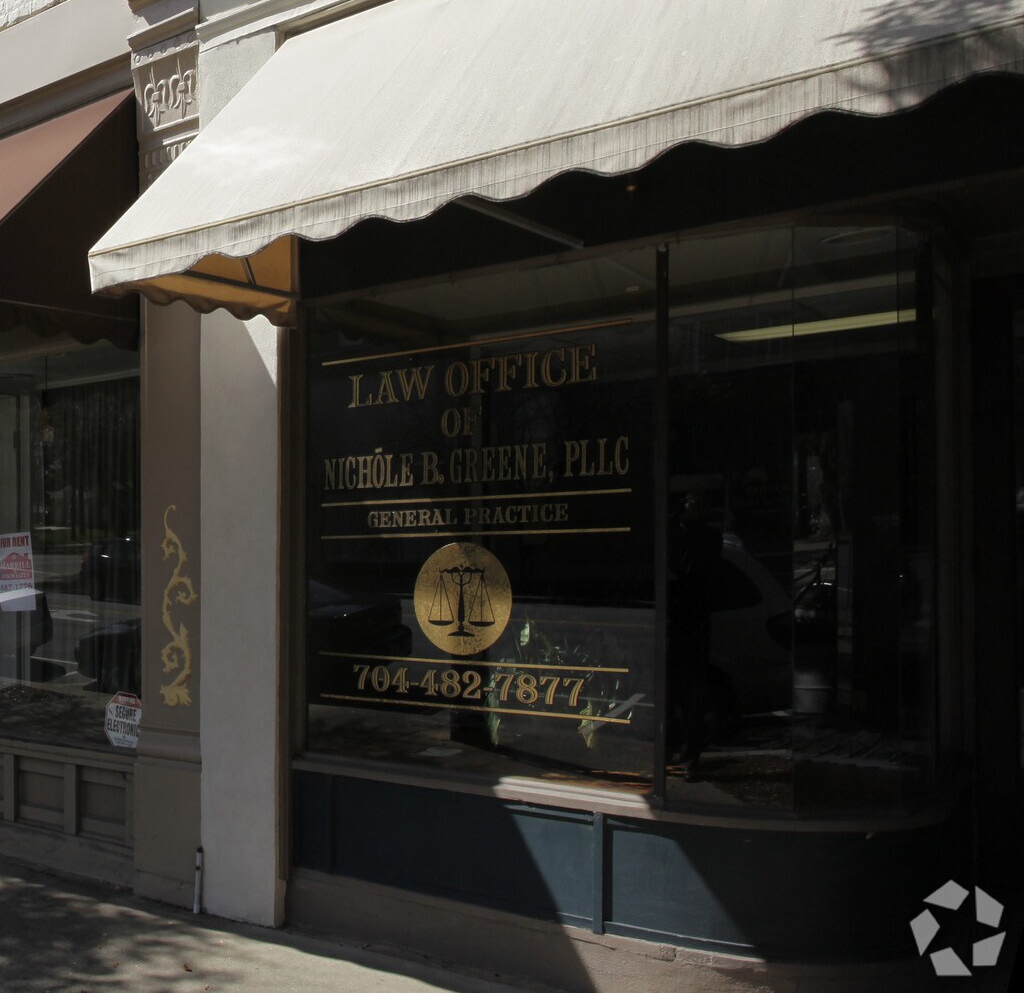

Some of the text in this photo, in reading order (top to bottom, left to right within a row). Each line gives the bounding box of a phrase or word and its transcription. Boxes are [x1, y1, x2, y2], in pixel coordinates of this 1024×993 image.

[347, 343, 597, 408] LAW OFFICE
[440, 405, 482, 438] OF
[420, 451, 445, 486] B.
[449, 443, 554, 484] GREENE,
[562, 436, 630, 478] PLLC
[367, 502, 568, 528] GENERAL PRACTICE
[0, 536, 29, 548] FOR RENT
[353, 664, 585, 707] 704-482-7877
[115, 705, 137, 722] SECURE
